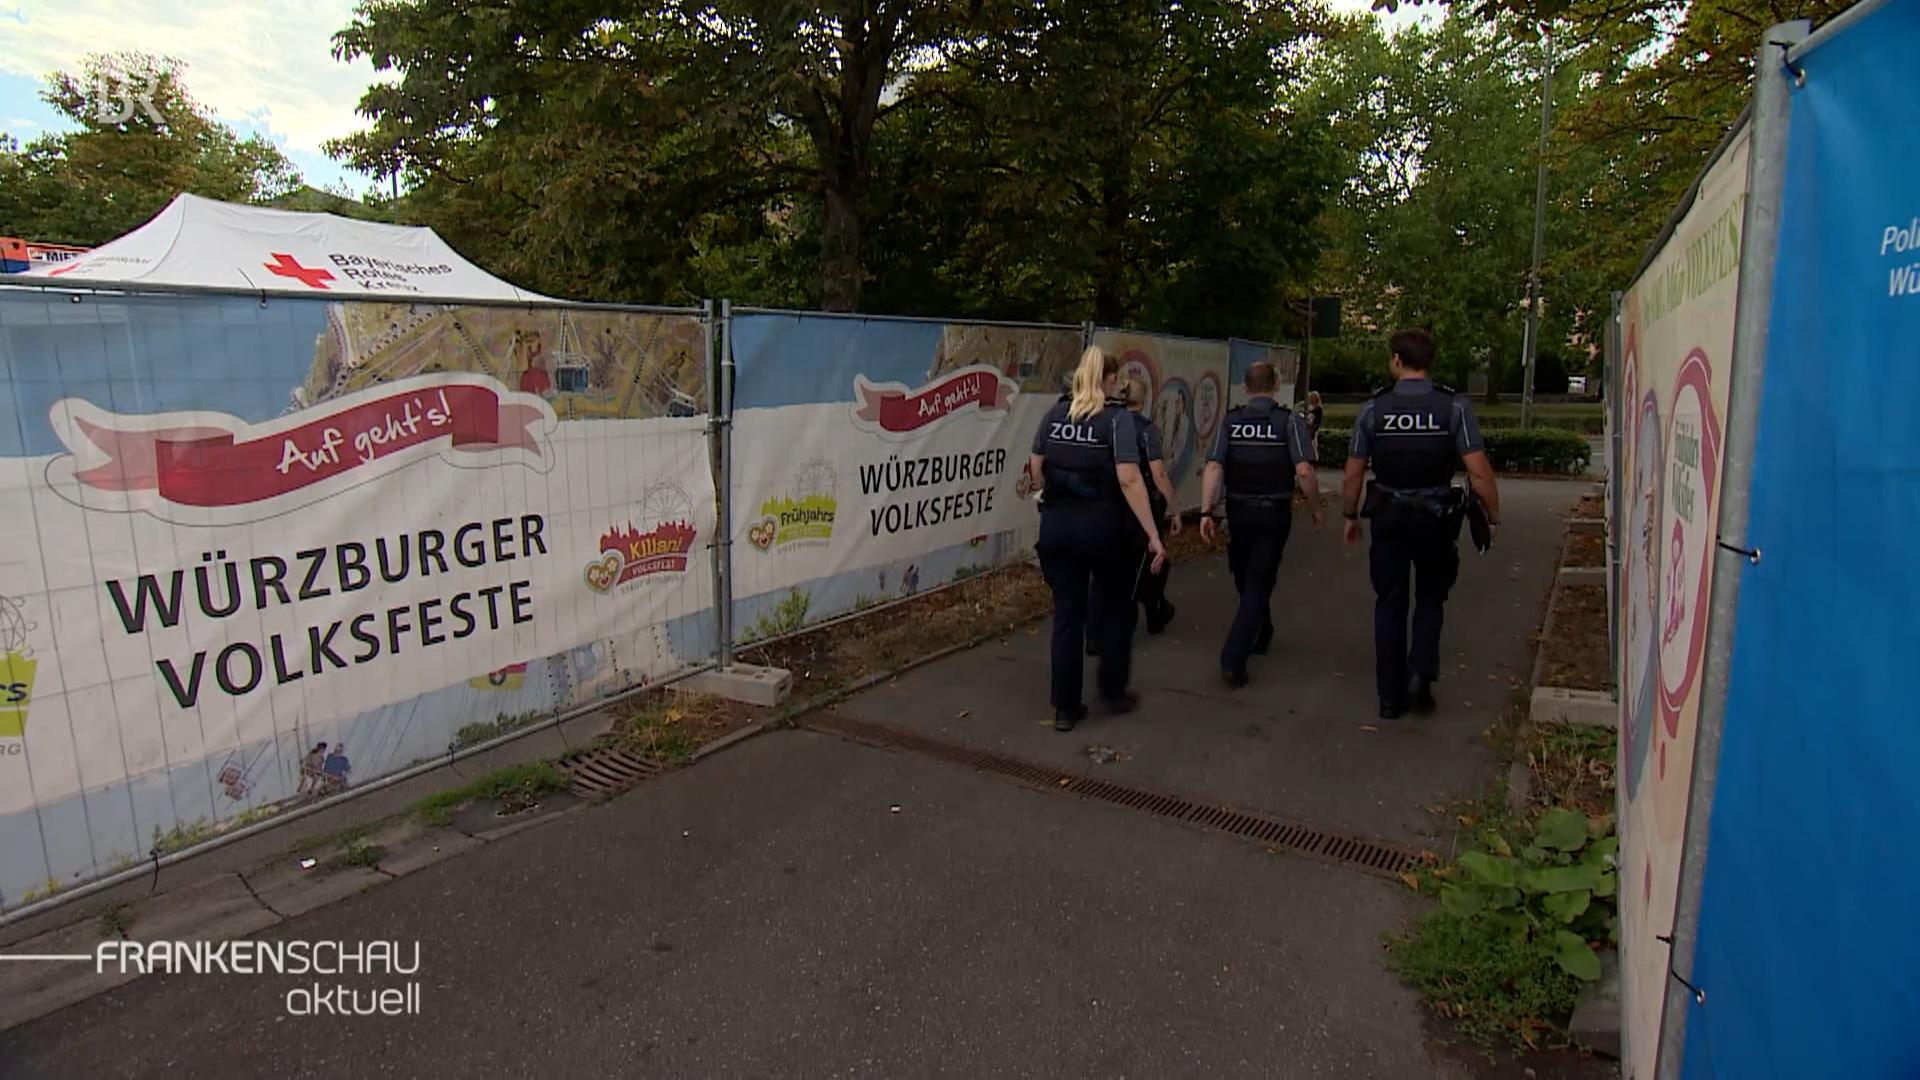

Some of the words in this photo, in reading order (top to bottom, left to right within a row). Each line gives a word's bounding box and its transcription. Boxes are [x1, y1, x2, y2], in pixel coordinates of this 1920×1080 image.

[329, 254, 452, 274] Bayerisches
[917, 394, 941, 418] Auf
[944, 373, 981, 412] geht's!
[276, 428, 344, 475] Auf
[354, 389, 452, 464] geht's!
[1050, 422, 1098, 442] ZOLL
[1231, 424, 1277, 439] ZOLL
[1383, 413, 1441, 430] ZOLL
[860, 448, 1006, 495] WÜRZBURGER
[871, 486, 995, 536] VOLKSFESTE
[106, 514, 548, 634] WÜRZBURGER
[156, 580, 533, 709] VOLKSFESTE
